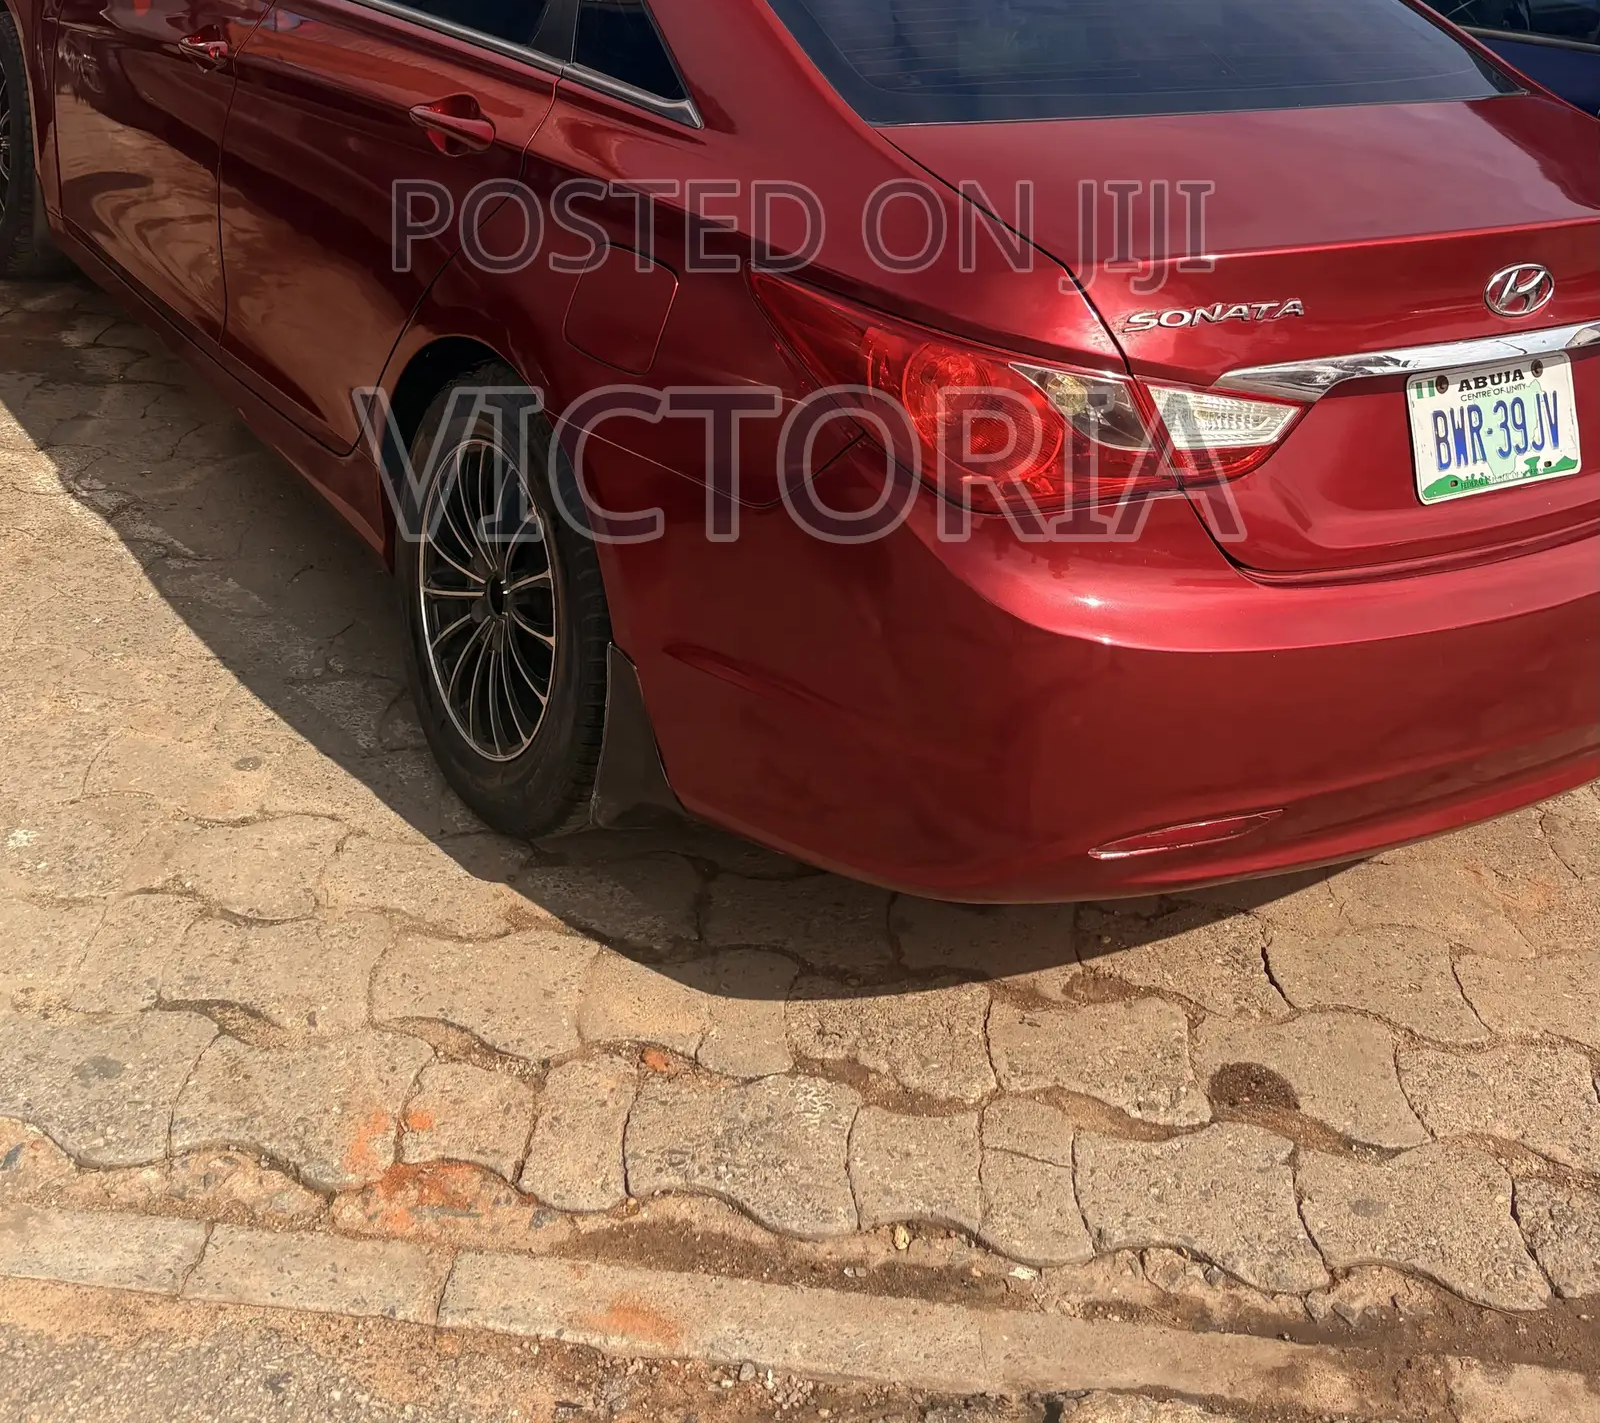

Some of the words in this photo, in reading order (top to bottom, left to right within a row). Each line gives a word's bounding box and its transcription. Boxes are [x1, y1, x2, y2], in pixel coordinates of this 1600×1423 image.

[1123, 298, 1305, 333] SONATA
[1458, 369, 1525, 393] ABUJA
[1461, 389, 1492, 403] CENTRE
[1492, 386, 1506, 397] OF
[1507, 384, 1528, 395] UNITY
